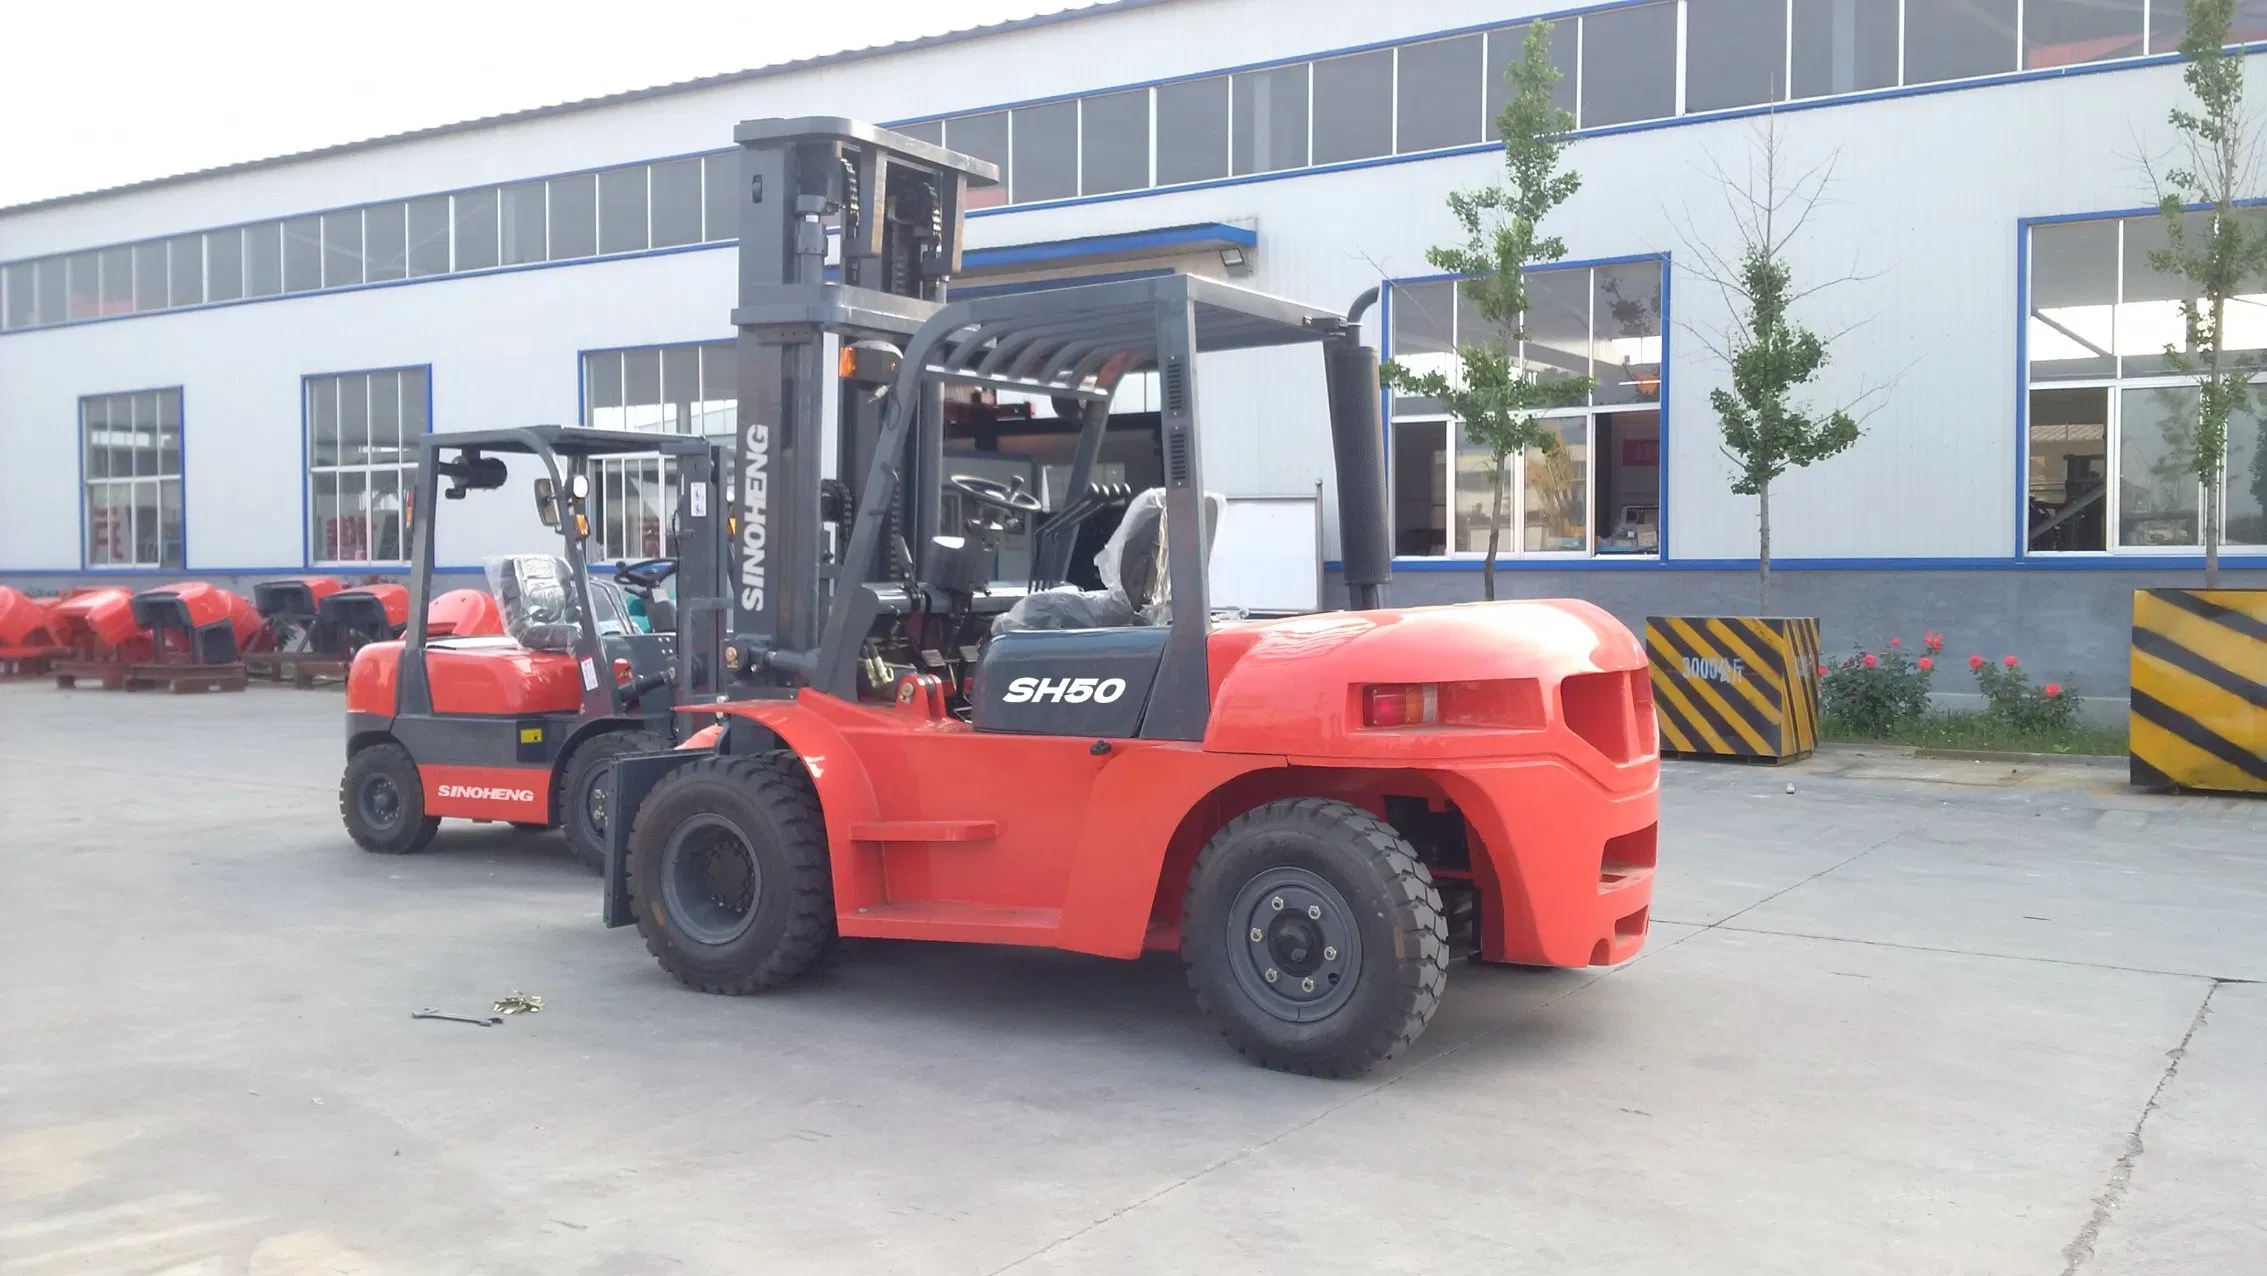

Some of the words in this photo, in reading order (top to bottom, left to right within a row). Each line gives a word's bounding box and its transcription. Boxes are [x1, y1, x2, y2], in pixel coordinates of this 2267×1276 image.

[741, 423, 769, 612] SINOHENG
[1002, 677, 1127, 704] SH50
[438, 784, 534, 802] SINOHENG
